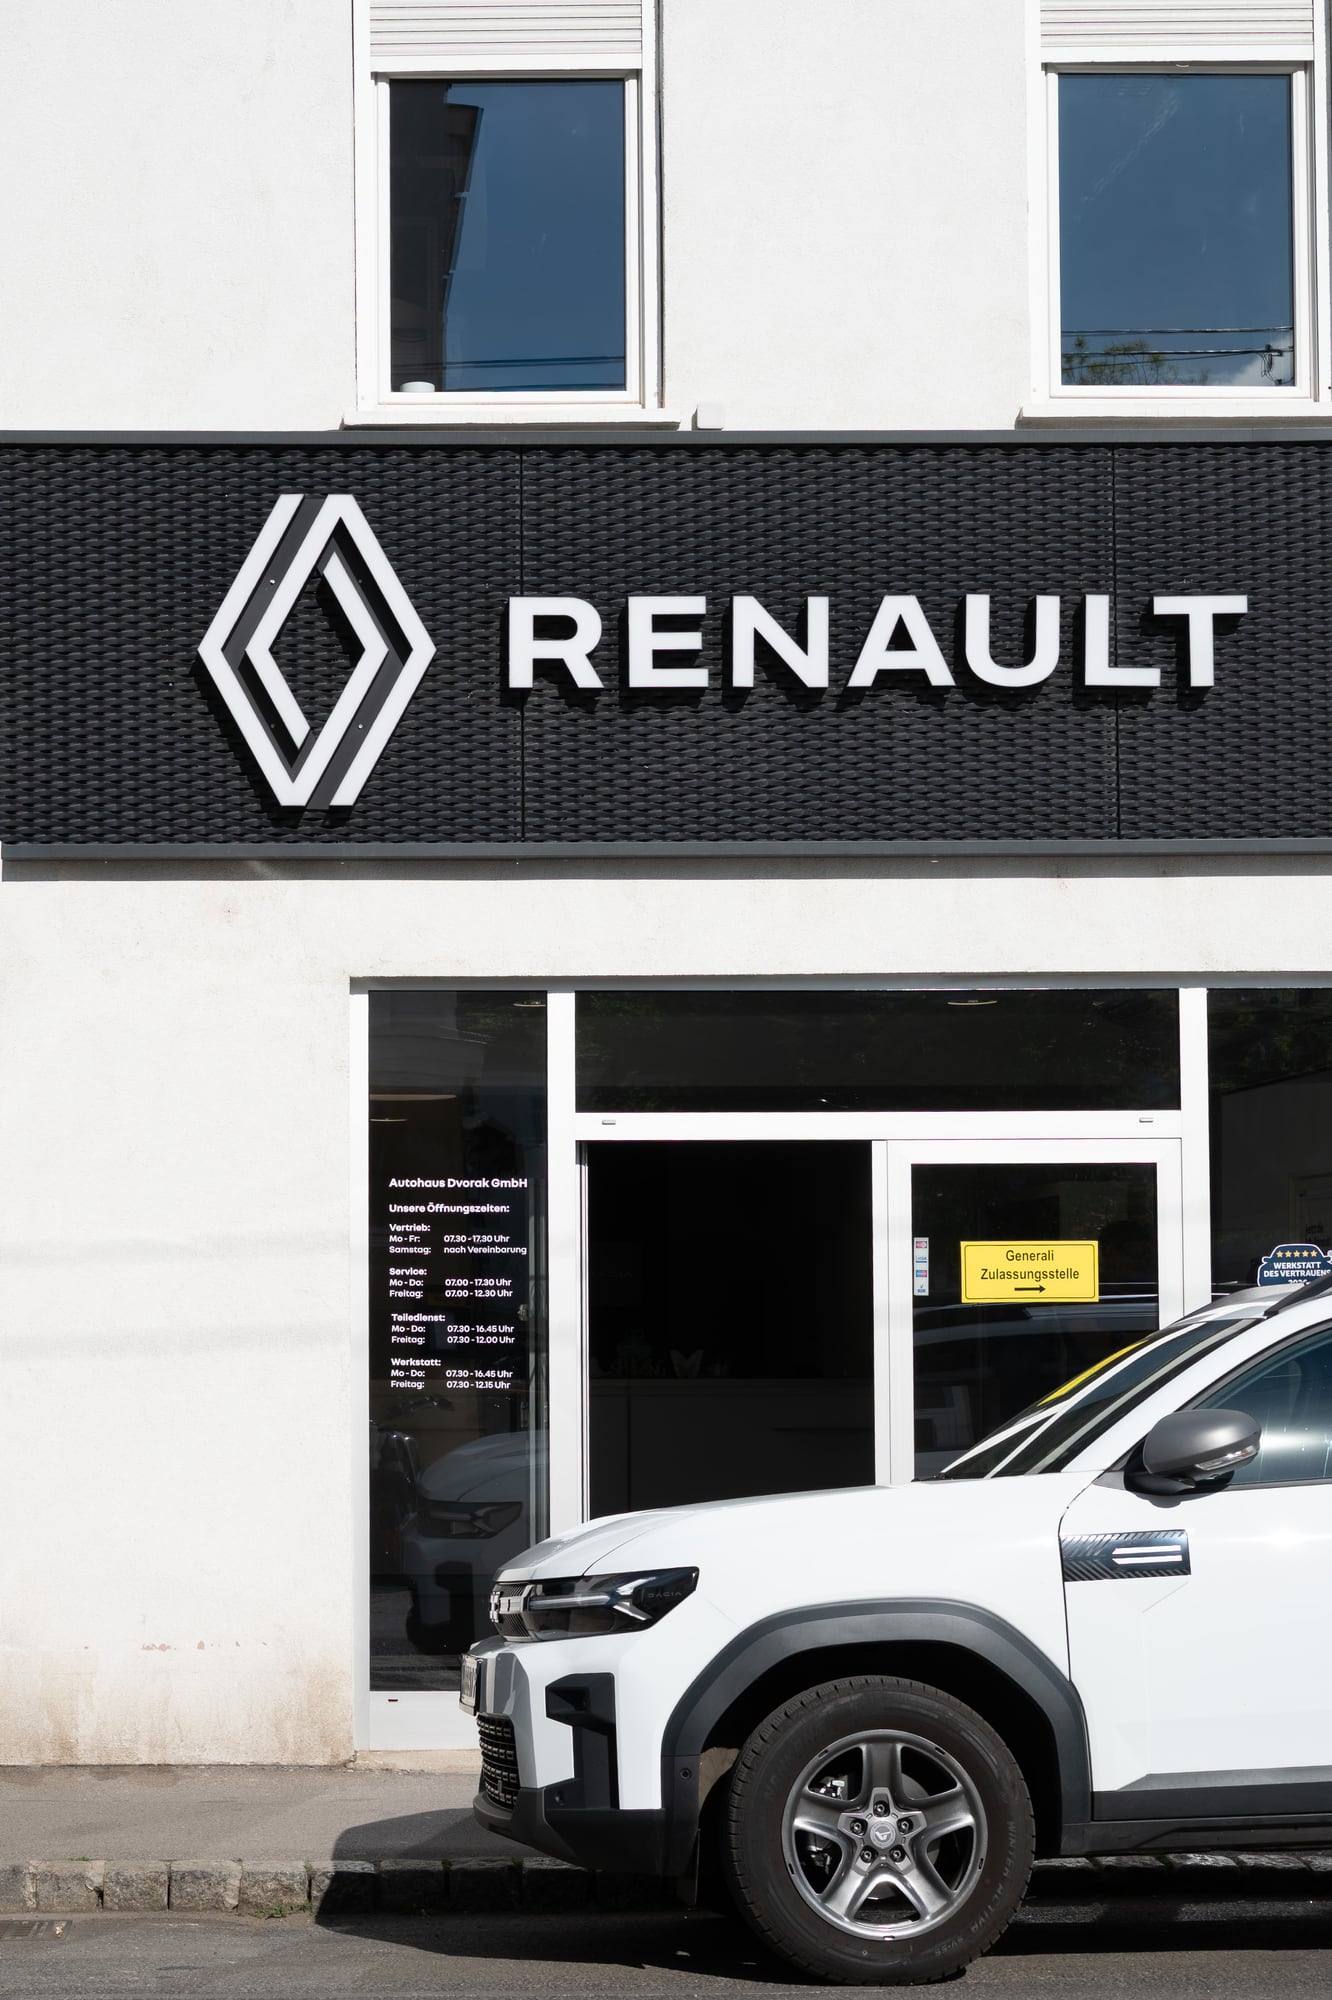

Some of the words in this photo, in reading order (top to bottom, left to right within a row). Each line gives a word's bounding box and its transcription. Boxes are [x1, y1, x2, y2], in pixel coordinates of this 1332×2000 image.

[508, 594, 1249, 689] RENAULT
[389, 1178, 446, 1188] Autohaus
[447, 1178, 490, 1188] Dvorak
[491, 1178, 528, 1188] GmbH
[389, 1204, 426, 1213] Unsere
[427, 1202, 510, 1215] Öffnungszeiten:
[389, 1223, 431, 1232] Vertrieb:
[389, 1246, 431, 1255] Samstag:
[467, 1246, 527, 1255] Vereinbarung
[1006, 1249, 1054, 1261] Generali
[1273, 1261, 1322, 1269] WERKSTATT
[389, 1267, 427, 1276] Service:
[980, 1268, 1080, 1282] Zulassungsstelle
[389, 1290, 423, 1299] Freitag:
[391, 1336, 425, 1345] Freitag:
[390, 1358, 441, 1366] Werkstatt:
[390, 1381, 425, 1390] Freitag:
